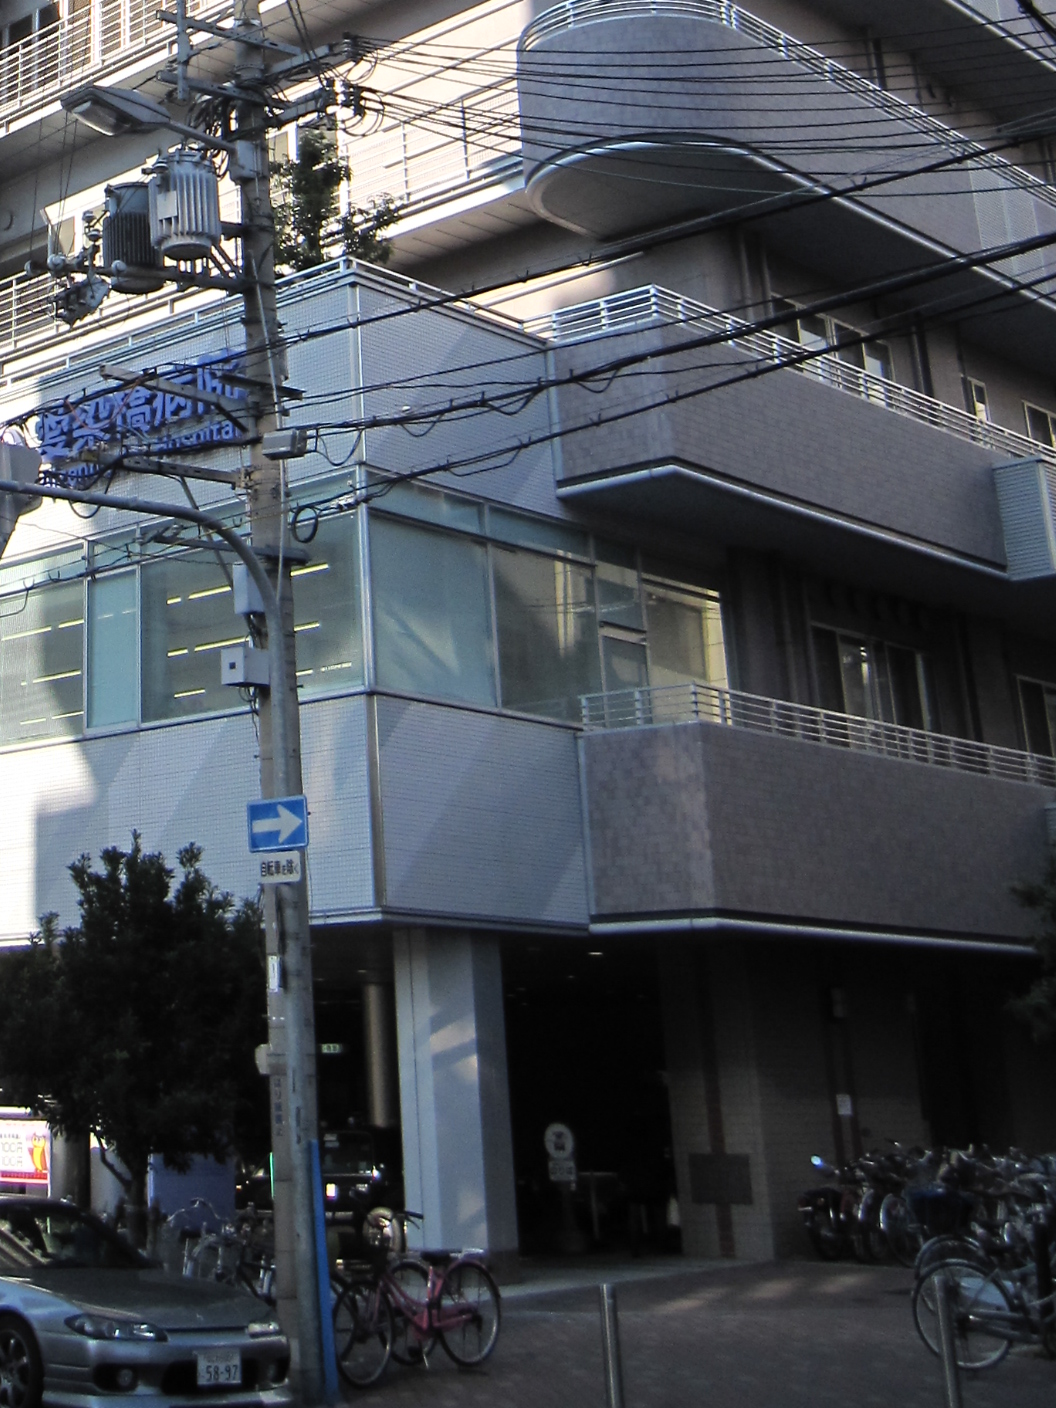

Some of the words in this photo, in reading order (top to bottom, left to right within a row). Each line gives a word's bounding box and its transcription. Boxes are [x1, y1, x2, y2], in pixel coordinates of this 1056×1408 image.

[260, 859, 300, 878] 自転車を除く
[205, 1364, 239, 1382] 58-97
